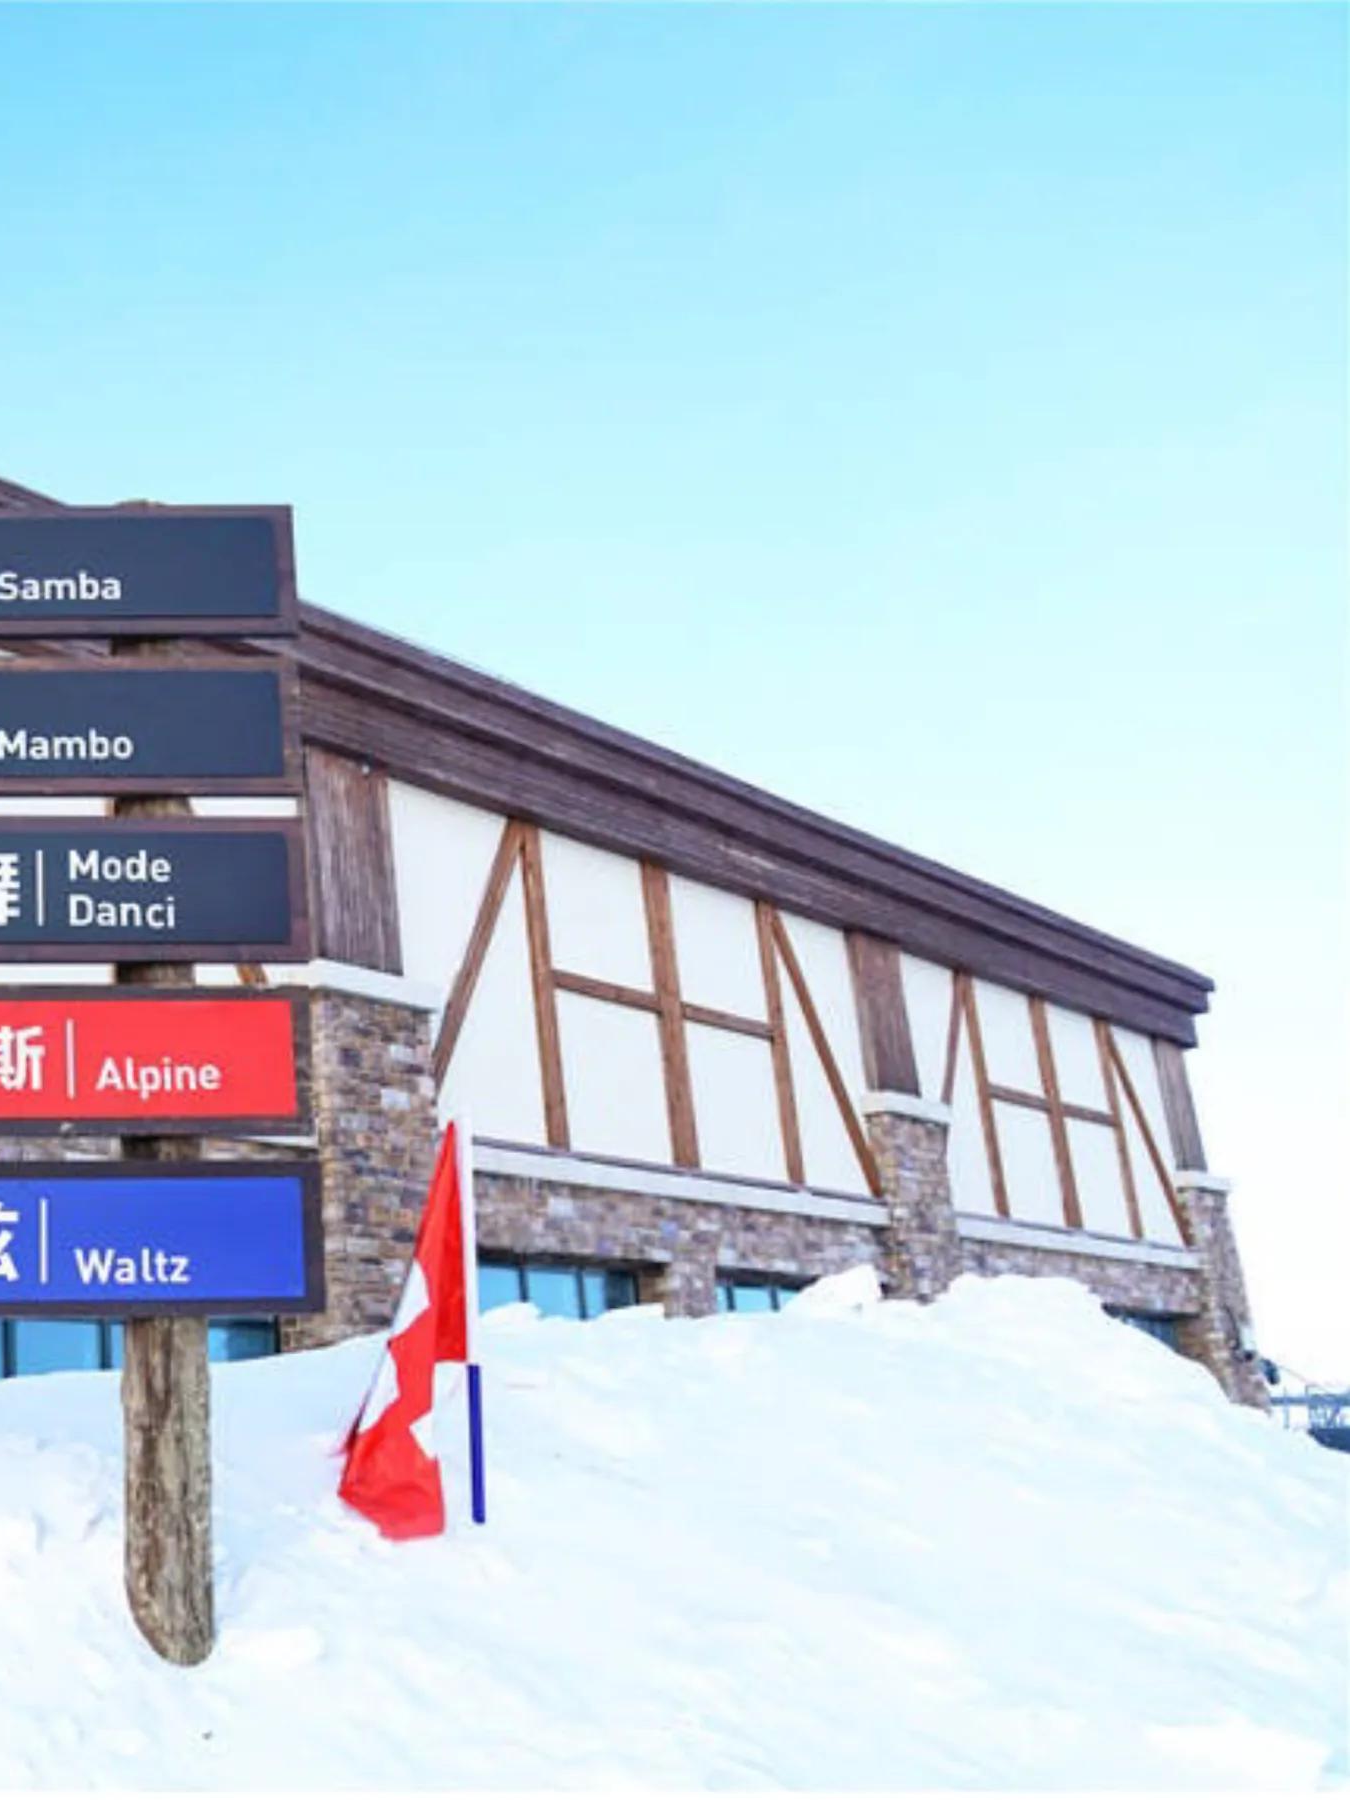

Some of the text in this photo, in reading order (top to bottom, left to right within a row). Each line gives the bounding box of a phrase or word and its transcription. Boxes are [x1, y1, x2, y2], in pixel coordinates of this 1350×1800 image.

[68, 850, 172, 884] Mode
[68, 894, 176, 930] Danci
[95, 1057, 222, 1101] Alpine
[74, 1247, 190, 1285] Waltz
